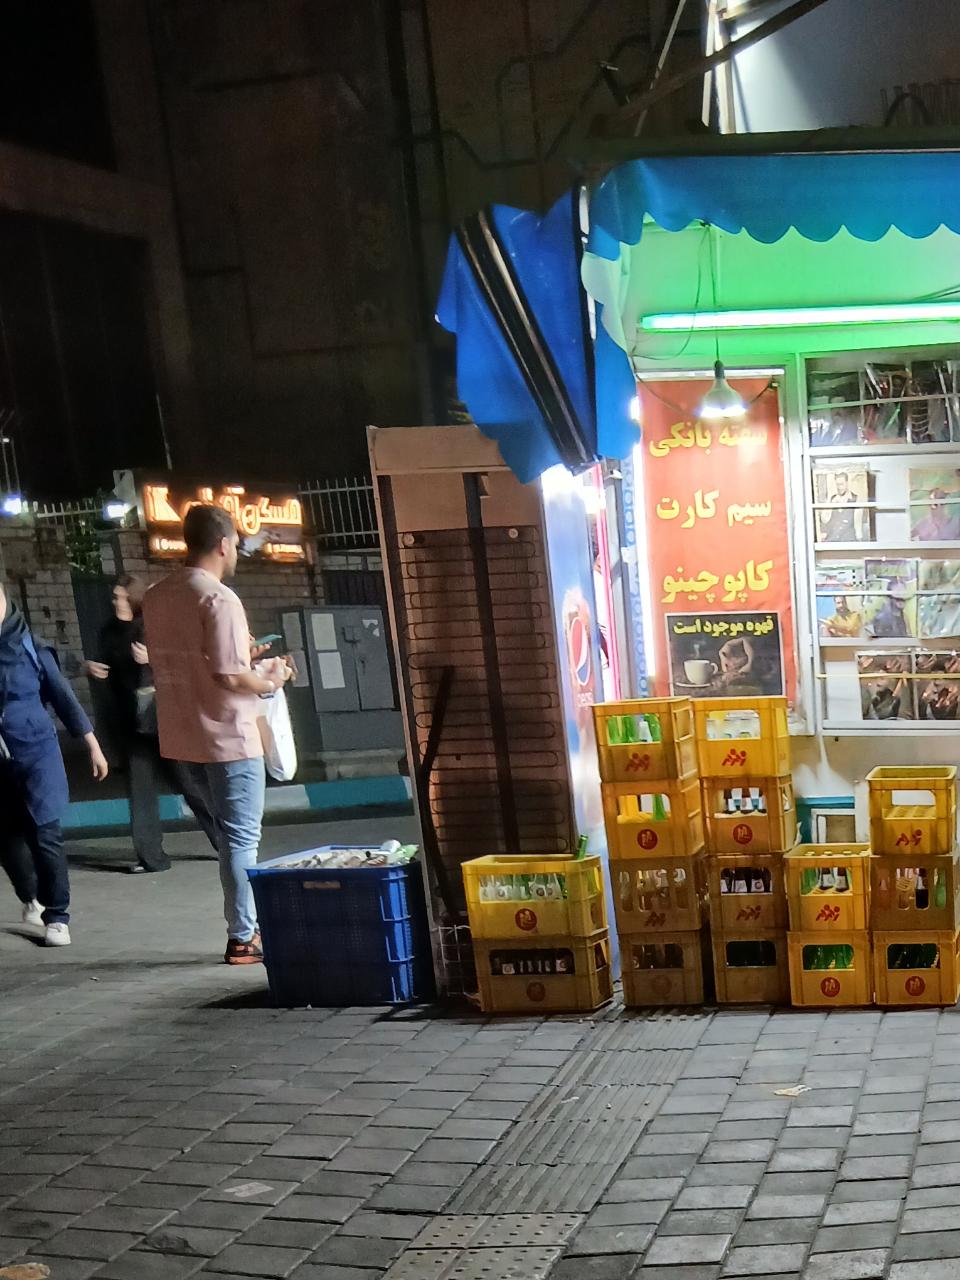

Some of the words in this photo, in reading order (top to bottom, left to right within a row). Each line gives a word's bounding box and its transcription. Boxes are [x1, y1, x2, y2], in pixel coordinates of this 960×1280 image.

[649, 421, 712, 457] بانکی
[656, 488, 720, 529] کارت
[727, 500, 772, 528] سیم
[672, 618, 702, 634] است
[703, 620, 745, 637] موجود
[745, 614, 775, 636] قهوه
